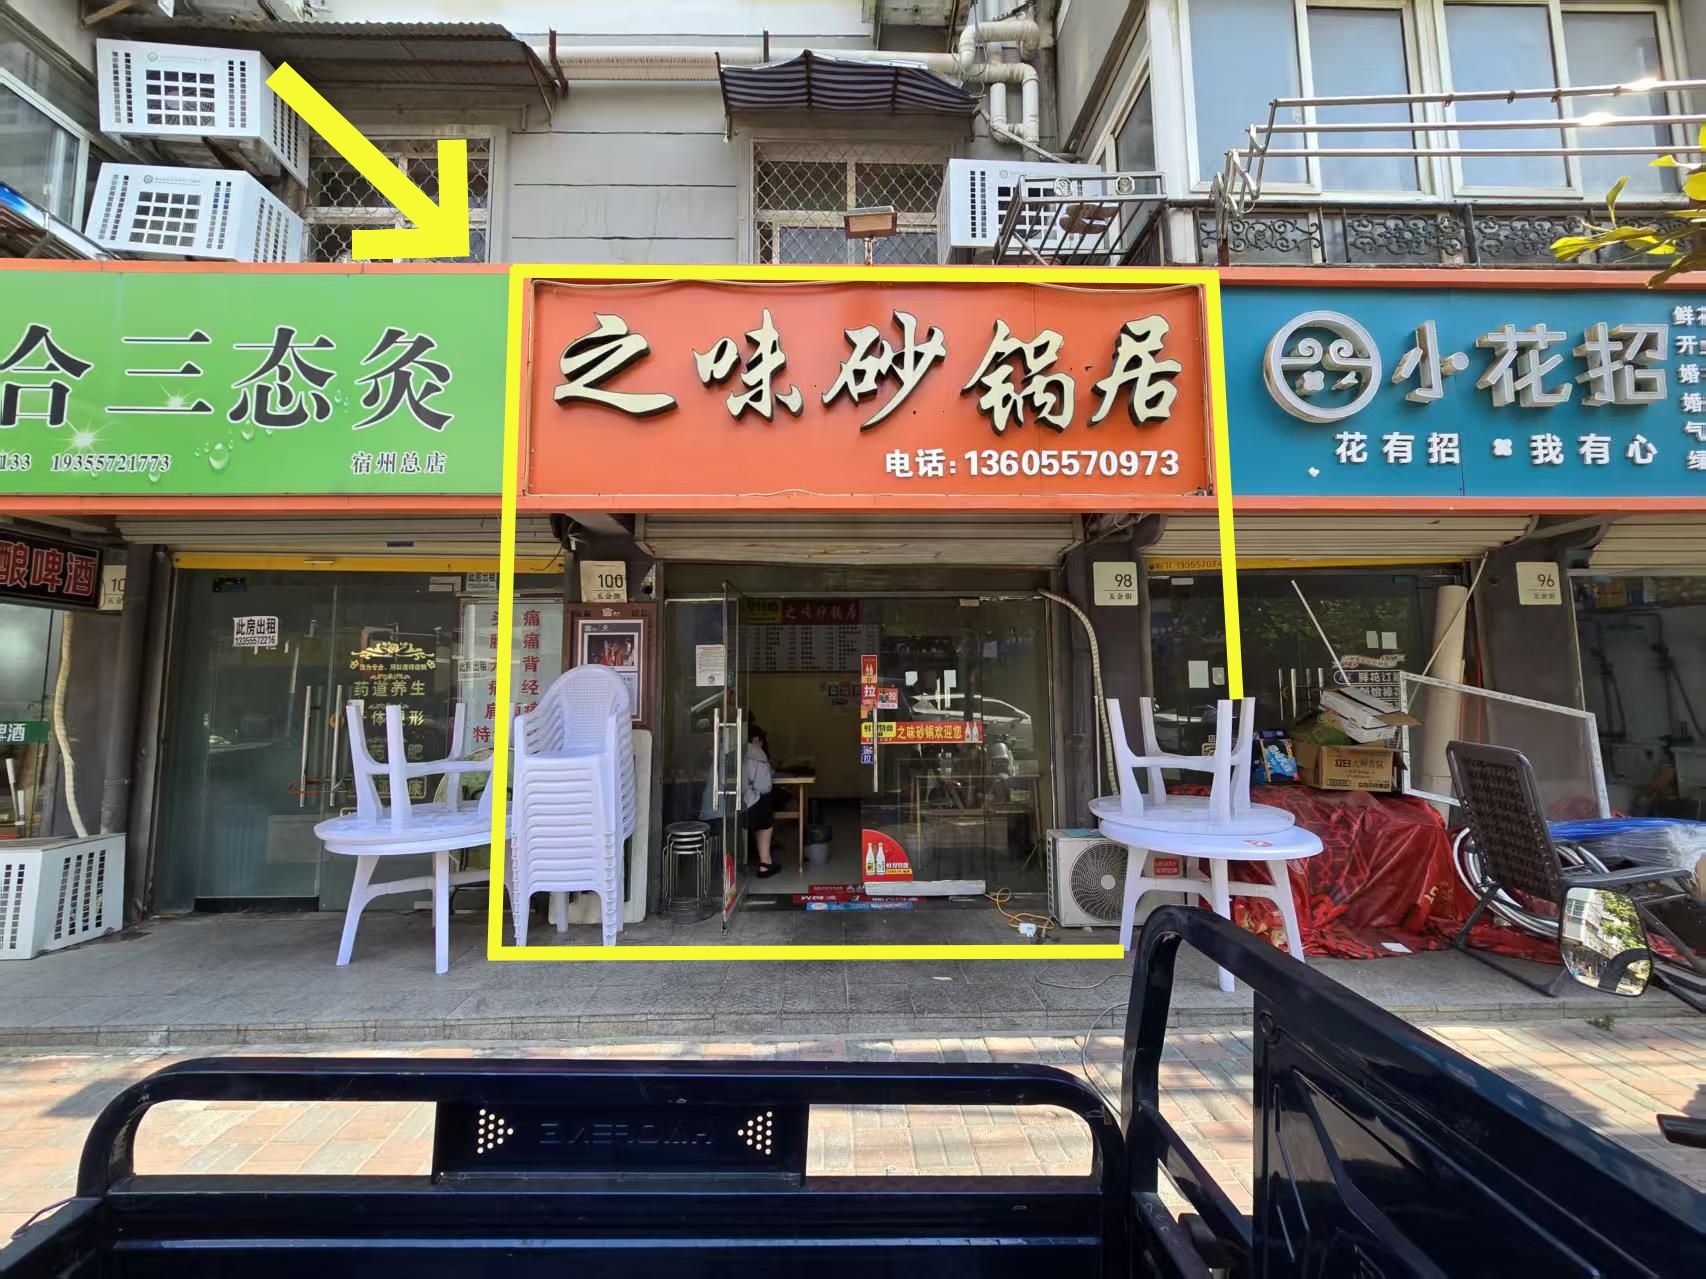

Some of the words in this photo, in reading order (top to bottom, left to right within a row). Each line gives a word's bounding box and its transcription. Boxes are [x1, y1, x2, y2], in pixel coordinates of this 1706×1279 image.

[553, 307, 1184, 433] 之味砂锅居
[1391, 320, 1671, 409] 小花招
[0, 323, 455, 431] 合三态灸
[1335, 431, 1461, 465] 花有招
[1530, 433, 1658, 466] 我有心
[51, 453, 172, 472] 19355721773
[351, 451, 447, 475] 宿州总店
[884, 448, 1180, 478] 电话:13605570973
[597, 574, 624, 589] 100
[1114, 573, 1133, 588] 98
[1537, 573, 1555, 588] 96
[235, 618, 276, 635] 此房出租
[353, 680, 426, 697] 药道养生
[863, 685, 876, 697] 拉
[897, 725, 962, 740] 之味砂锅欢迎您
